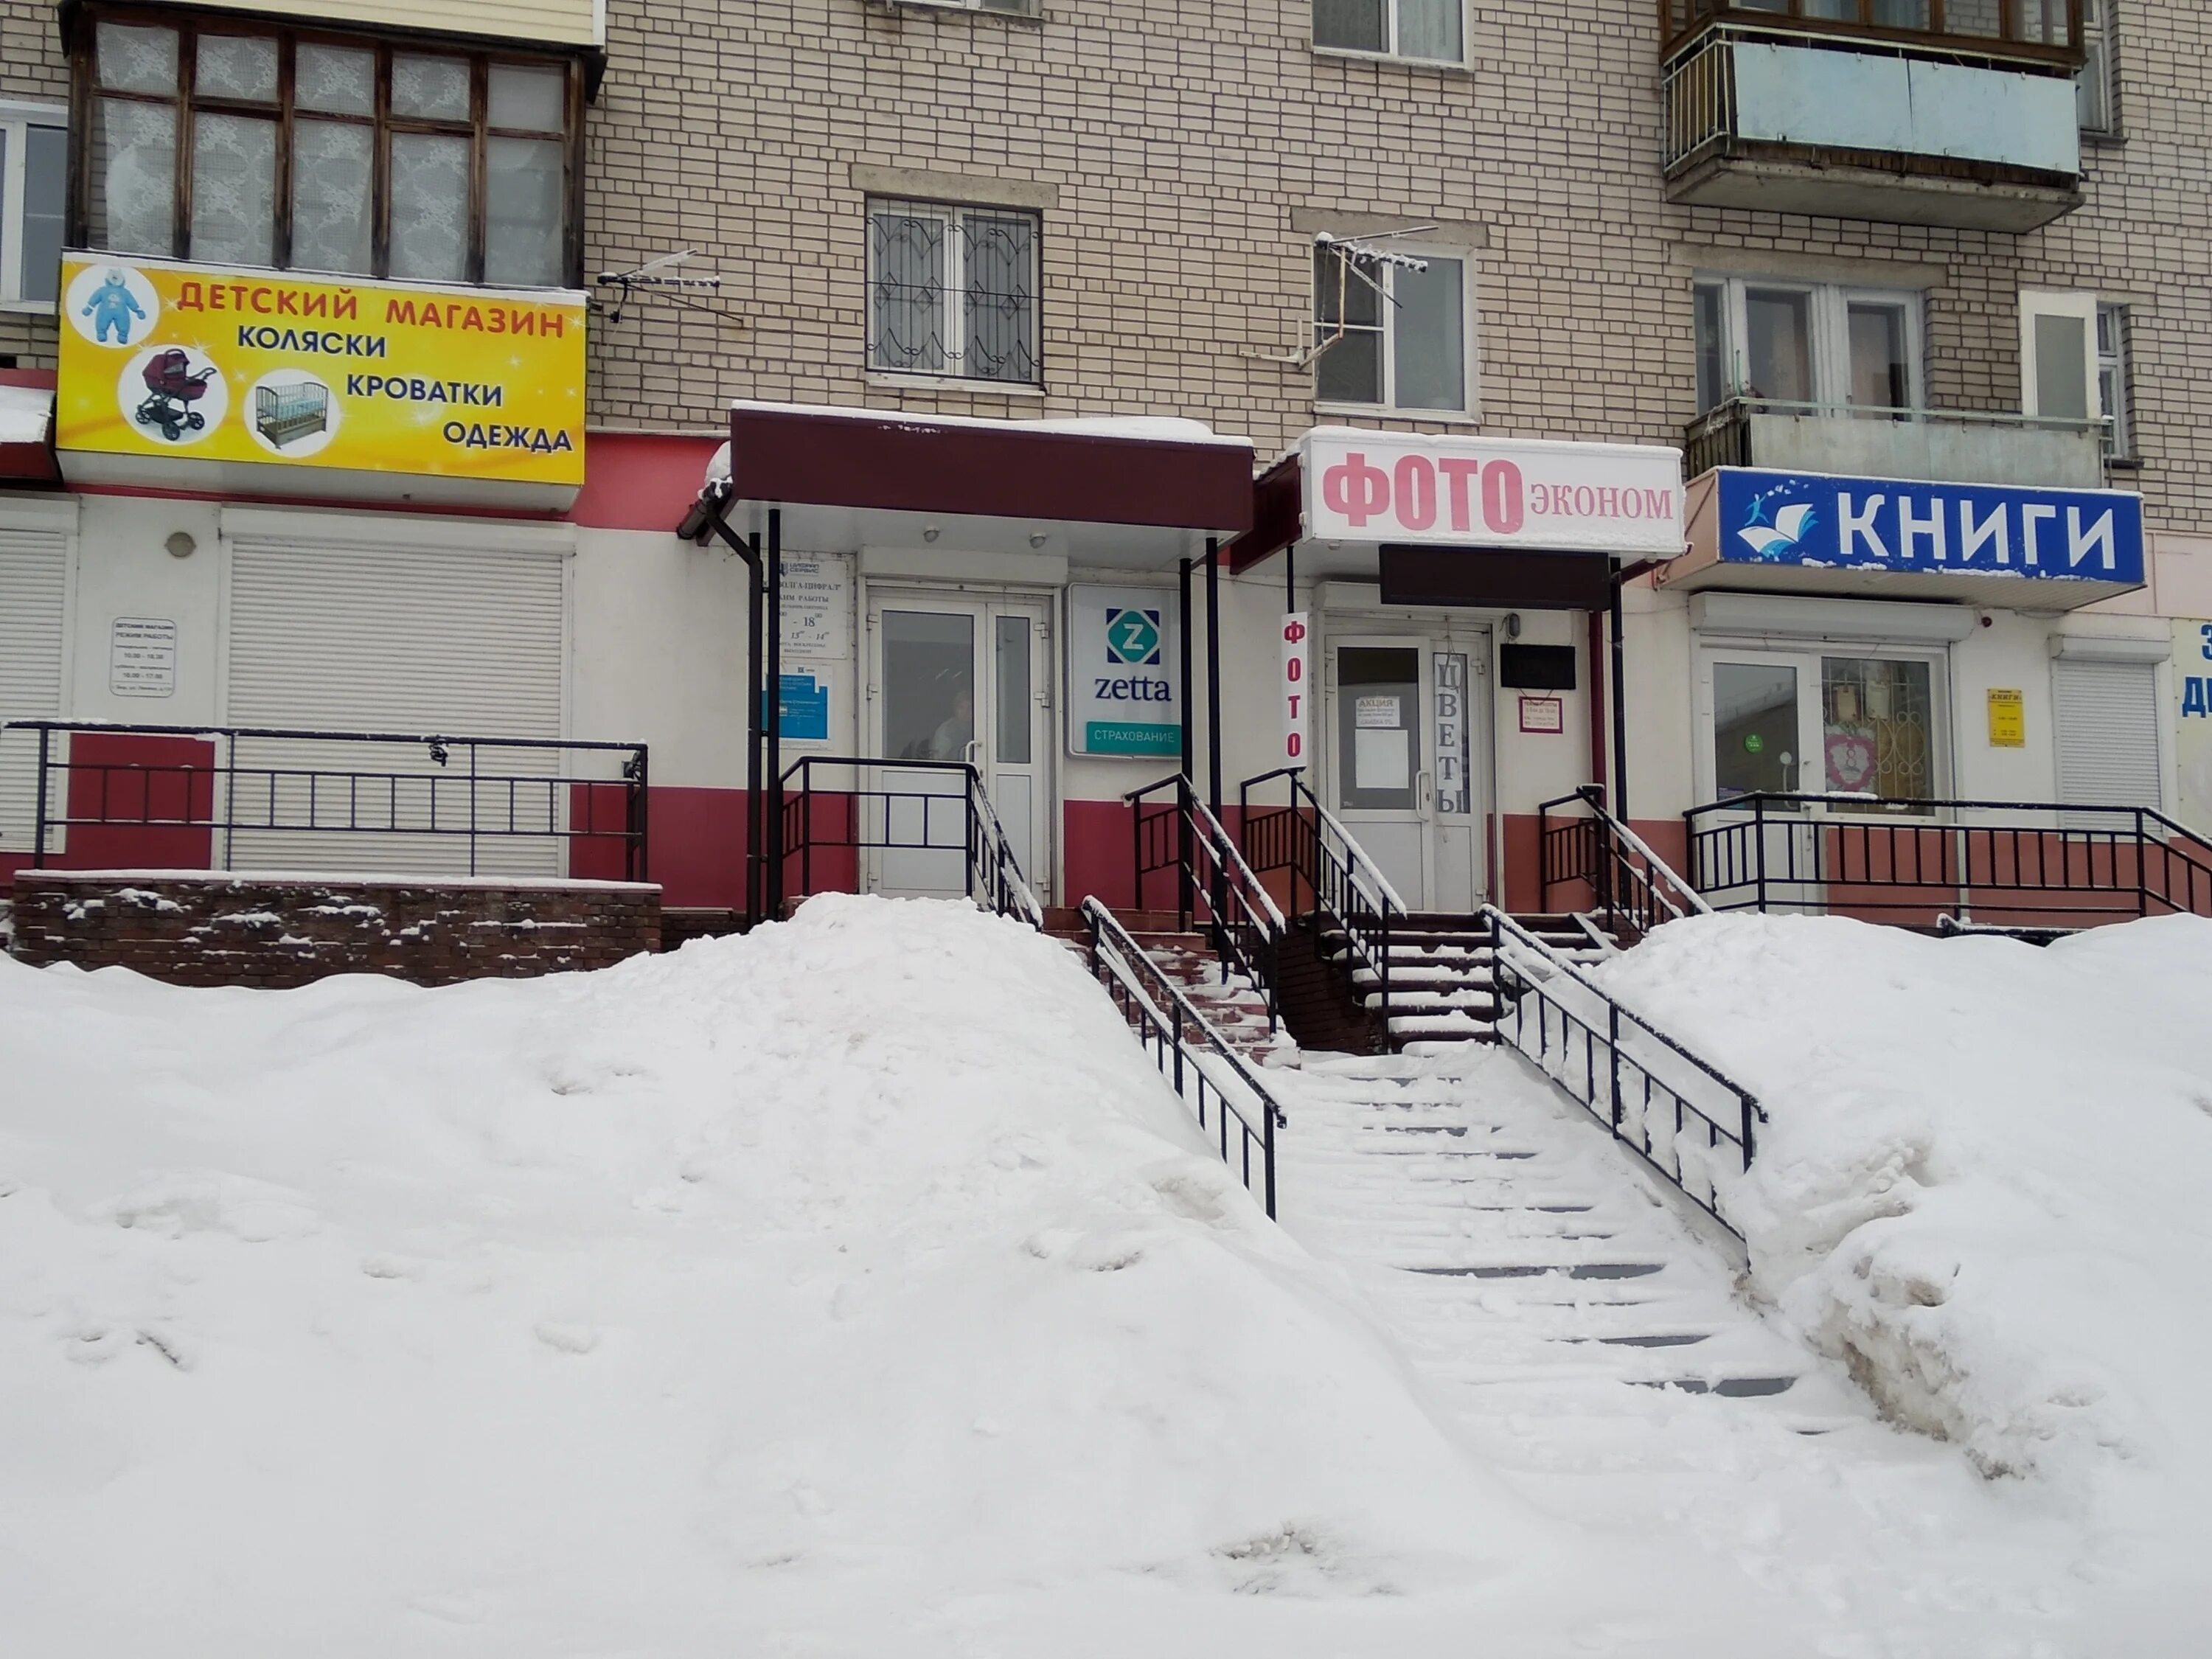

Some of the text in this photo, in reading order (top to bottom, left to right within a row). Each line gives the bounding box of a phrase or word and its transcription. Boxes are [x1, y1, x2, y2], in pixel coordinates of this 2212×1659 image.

[177, 281, 563, 338] ДЕТСКИЙ МАГАЗИН
[238, 325, 385, 358] КОЛЯСКИ
[347, 375, 501, 406] КРОВАТКИ
[442, 421, 572, 453] ОДЕЖДА
[1323, 453, 1673, 534] ФОТО ЭКОНОМ
[1837, 492, 2116, 569] КНИГИ
[1095, 676, 1172, 701] zetta
[1283, 621, 1306, 757] ФОТО
[1358, 699, 1394, 708] АКЦИЯ
[1094, 730, 1175, 742] СТРАХОВАНИЕ
[1437, 664, 1464, 813] ЦВЕТЫ
